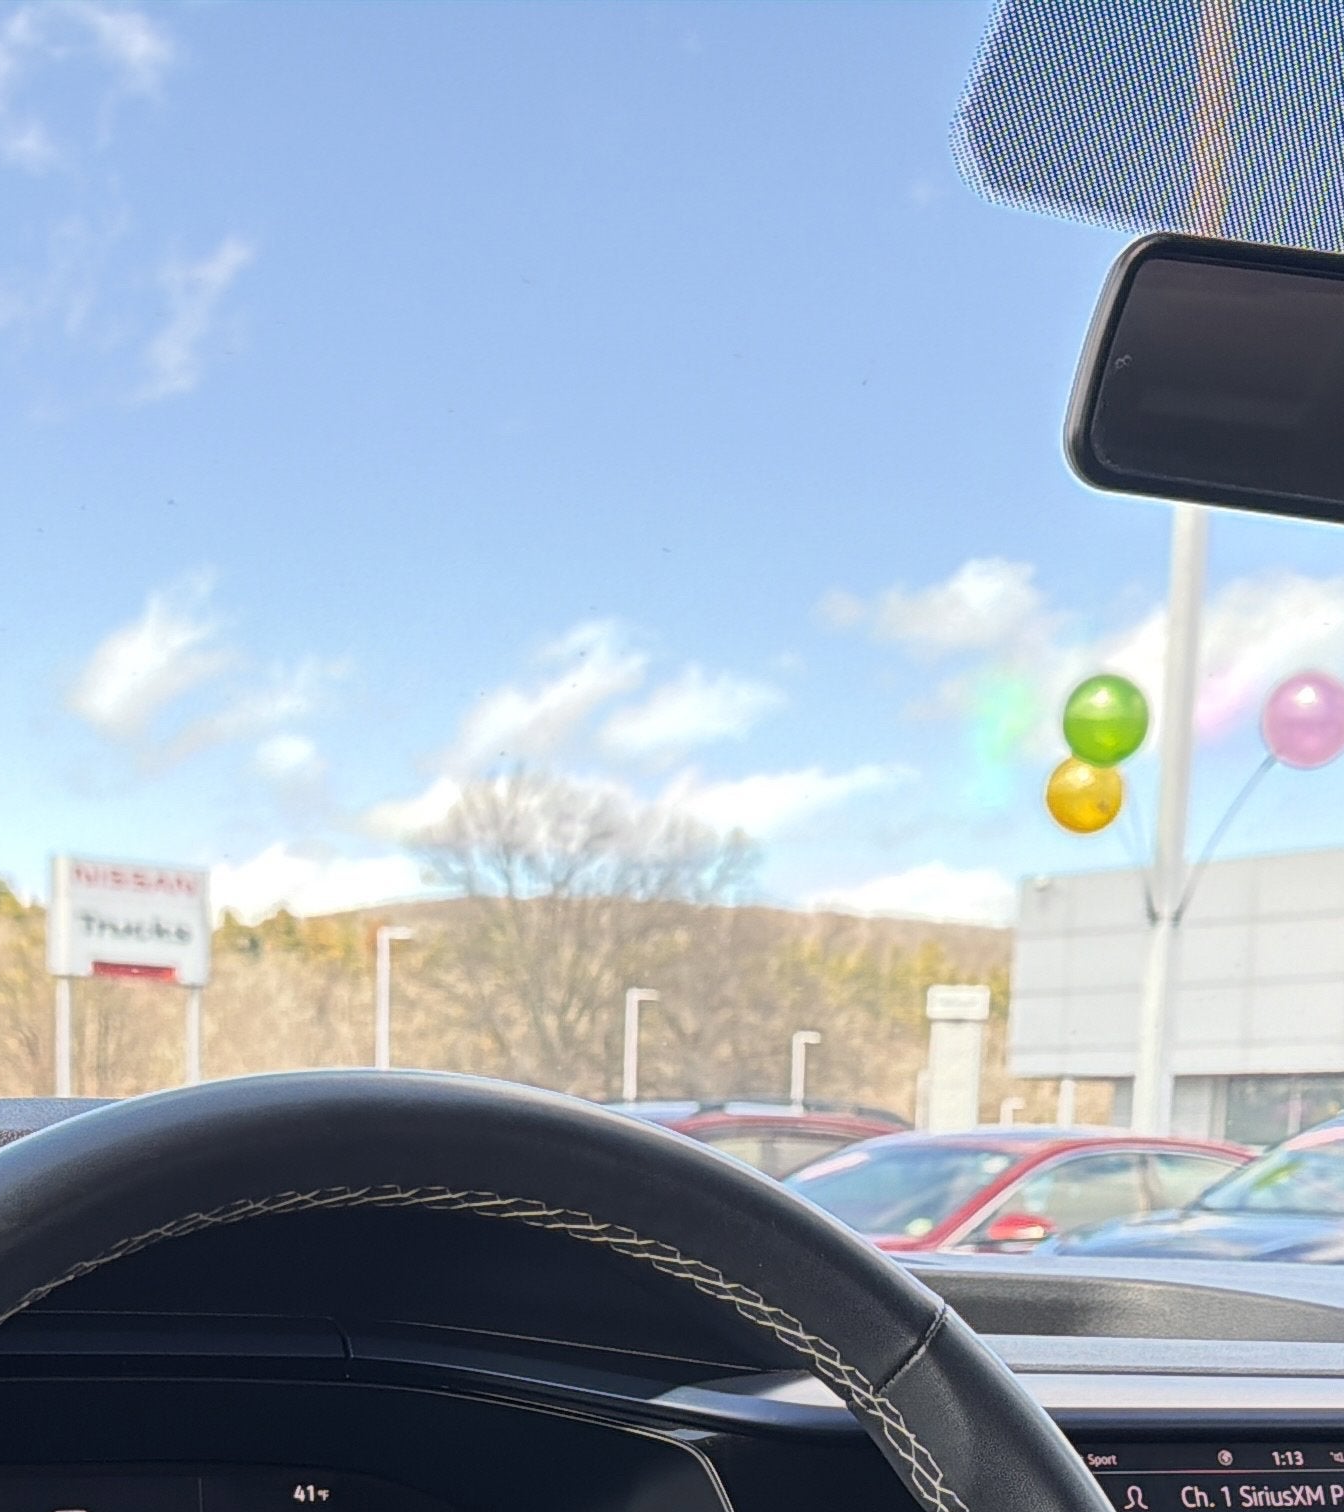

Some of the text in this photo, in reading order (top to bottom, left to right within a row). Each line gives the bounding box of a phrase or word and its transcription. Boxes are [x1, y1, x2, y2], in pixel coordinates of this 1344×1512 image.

[1086, 1454, 1118, 1468] Sport
[1271, 1450, 1305, 1467] 1:13
[1181, 1485, 1216, 1509] Ch.
[1220, 1486, 1232, 1508] 1
[1239, 1484, 1325, 1508] SiriusXM
